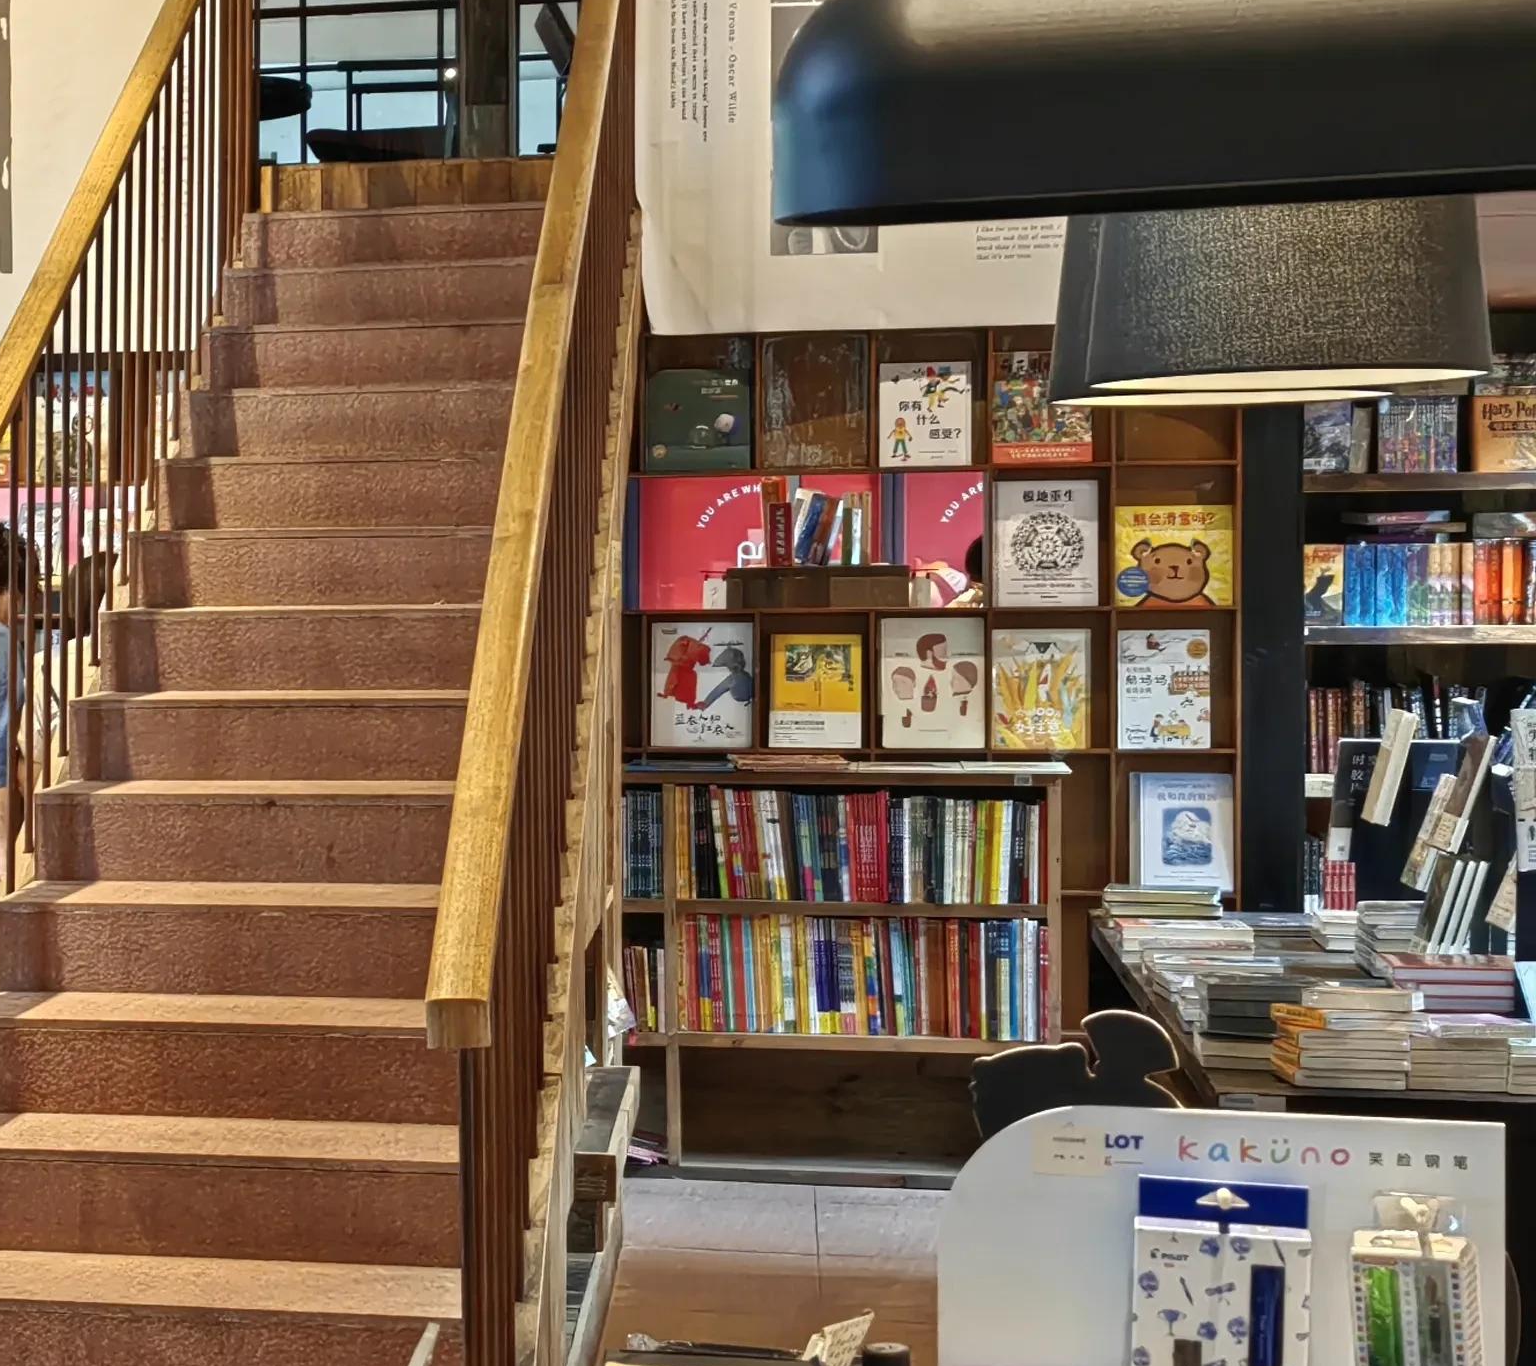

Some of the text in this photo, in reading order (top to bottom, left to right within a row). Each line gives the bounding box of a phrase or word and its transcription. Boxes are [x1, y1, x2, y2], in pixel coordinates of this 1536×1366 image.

[728, 91, 737, 124] Wilde
[695, 506, 716, 530] YOU
[716, 487, 740, 508] ARE
[940, 501, 960, 524] YOU
[1368, 1151, 1469, 1171] 笑脸钢笔
